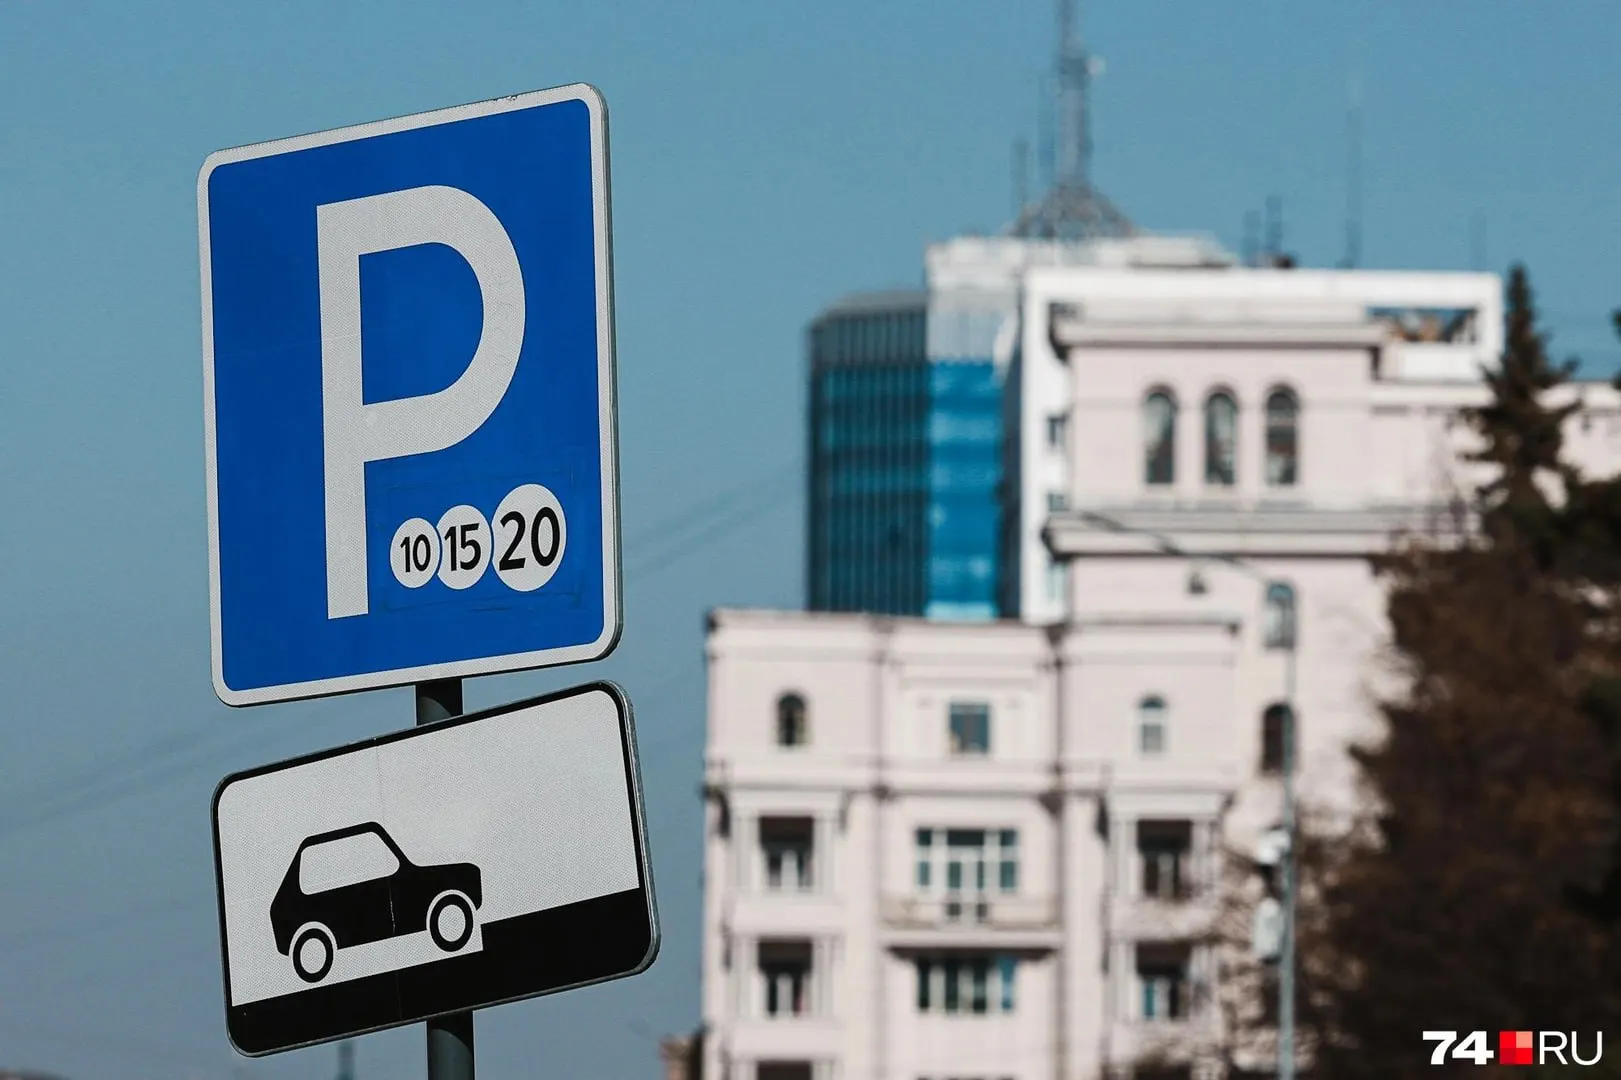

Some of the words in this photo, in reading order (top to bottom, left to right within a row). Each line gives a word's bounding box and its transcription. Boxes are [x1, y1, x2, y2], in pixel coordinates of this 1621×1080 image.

[316, 185, 526, 620] P
[400, 533, 431, 573] 10
[444, 522, 482, 572] 15
[499, 506, 561, 572] 20
